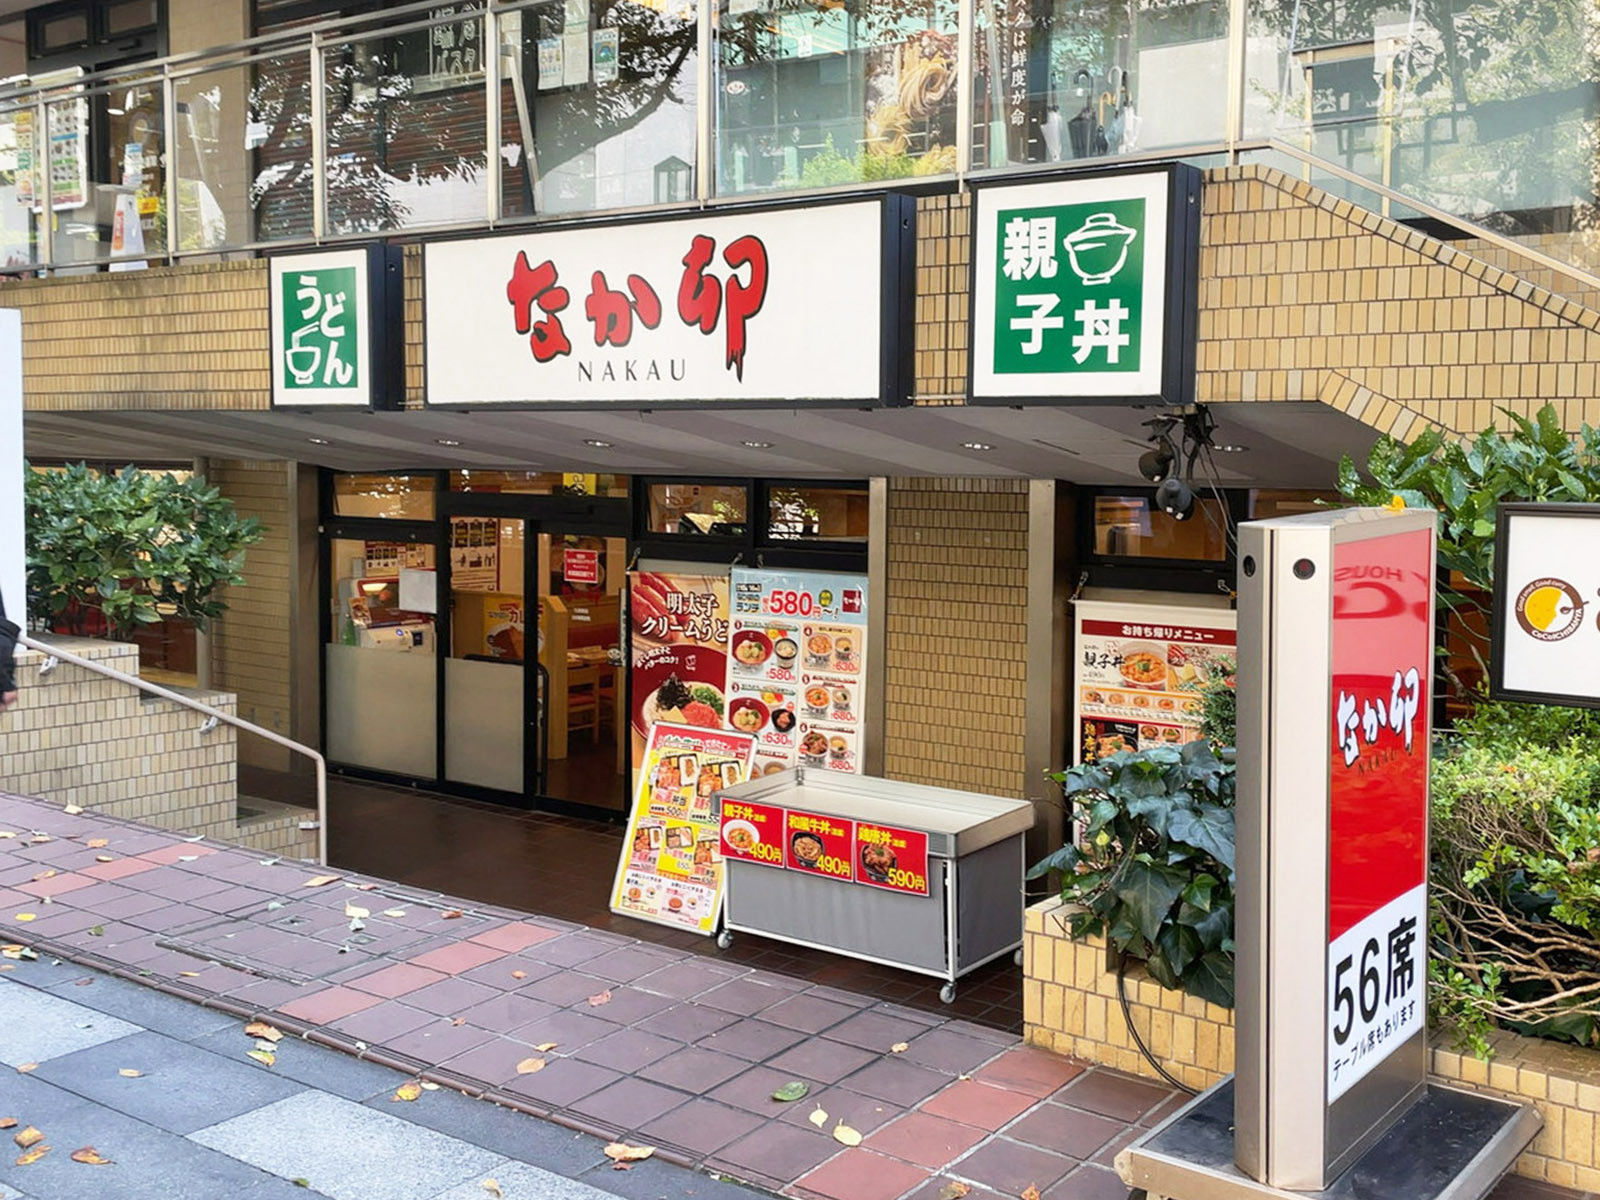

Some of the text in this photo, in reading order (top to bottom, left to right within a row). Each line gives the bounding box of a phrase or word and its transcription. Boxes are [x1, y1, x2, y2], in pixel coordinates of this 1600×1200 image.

[506, 233, 770, 384] なか卯
[295, 274, 354, 386] うどん
[578, 358, 686, 382] NAKAU
[666, 592, 719, 617] 明太子
[641, 616, 729, 642] クリームうど
[1122, 625, 1215, 641] お持ち帰りメニュー
[1336, 666, 1420, 768] なか卯
[749, 842, 782, 863] 490円
[816, 854, 851, 877] 490円
[887, 867, 926, 891] 590円
[1332, 915, 1418, 1046] 56席
[1332, 999, 1416, 1082] テーブル席もあります
